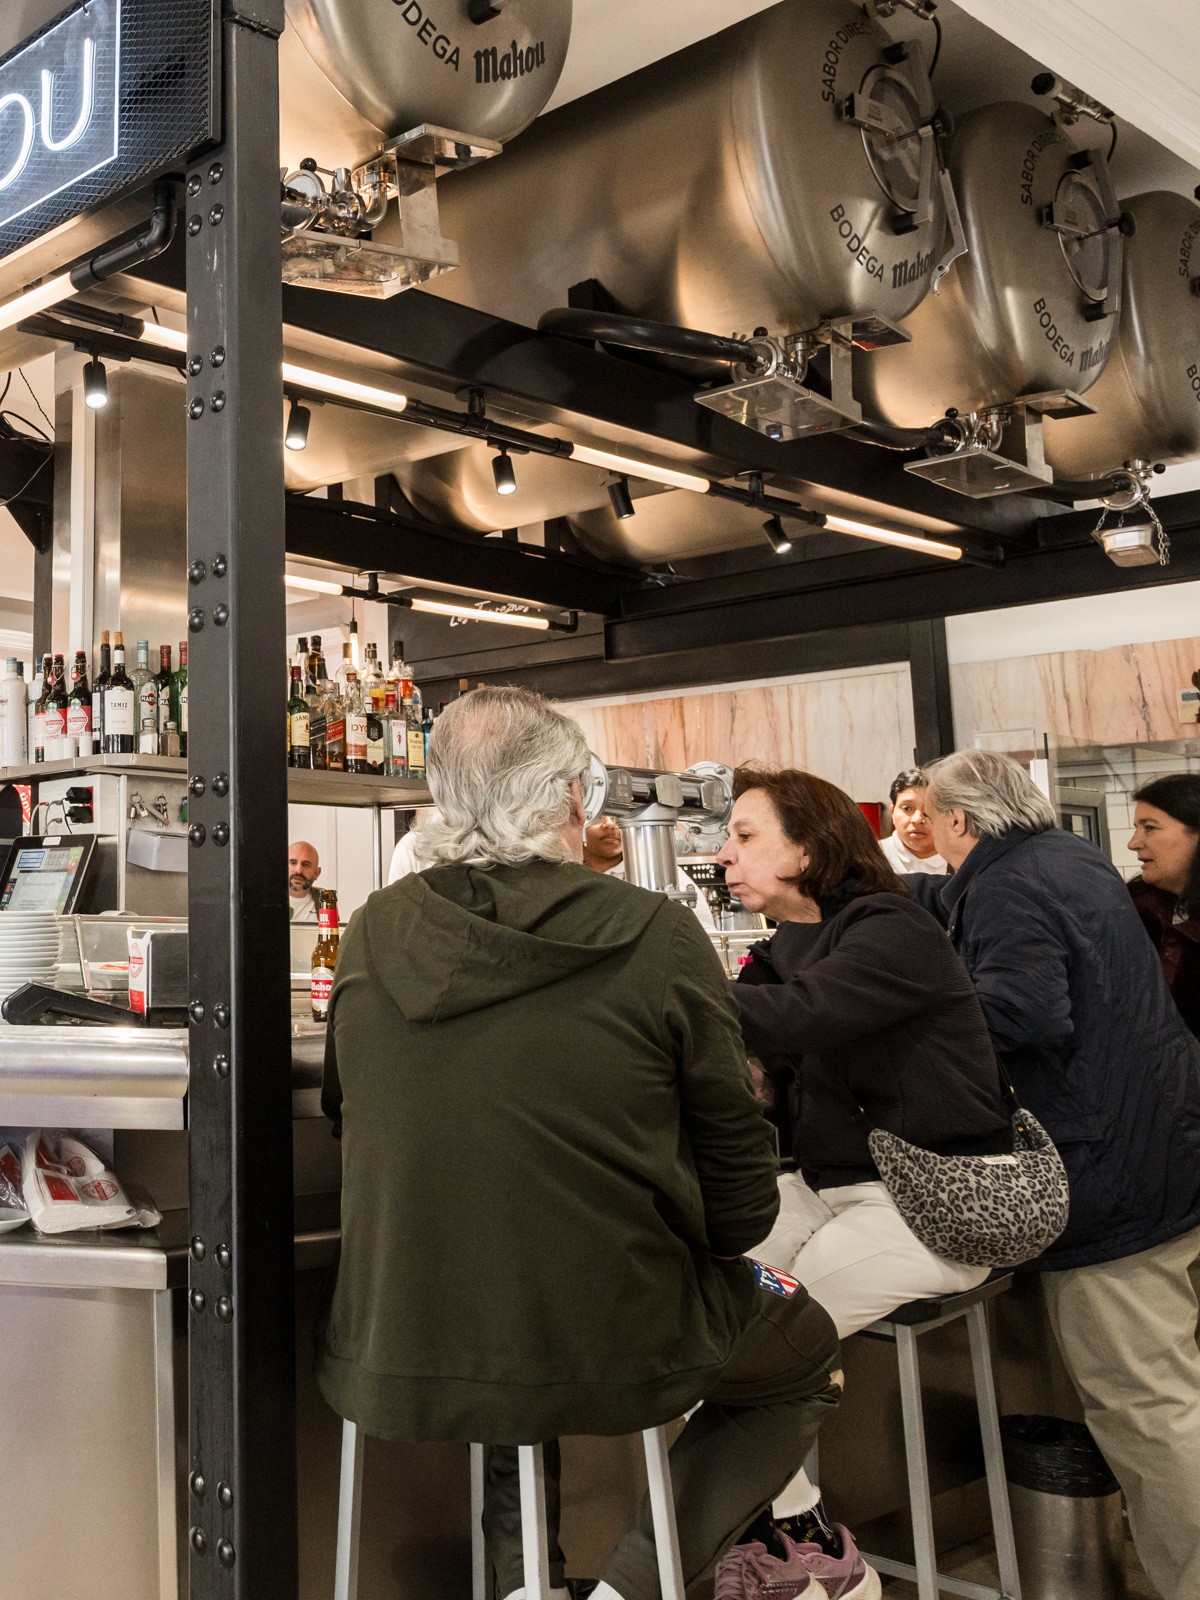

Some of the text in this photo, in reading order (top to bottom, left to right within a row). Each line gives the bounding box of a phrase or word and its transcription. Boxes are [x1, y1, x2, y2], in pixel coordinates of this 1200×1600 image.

[392, 0, 461, 72] DEGA
[474, 40, 545, 84] Mahou
[822, 40, 843, 104] SABOR
[1021, 149, 1039, 206] SABOR
[829, 203, 885, 283] BODEGA
[1178, 230, 1195, 279] SABOR
[1033, 297, 1108, 373] BODEGA Mah
